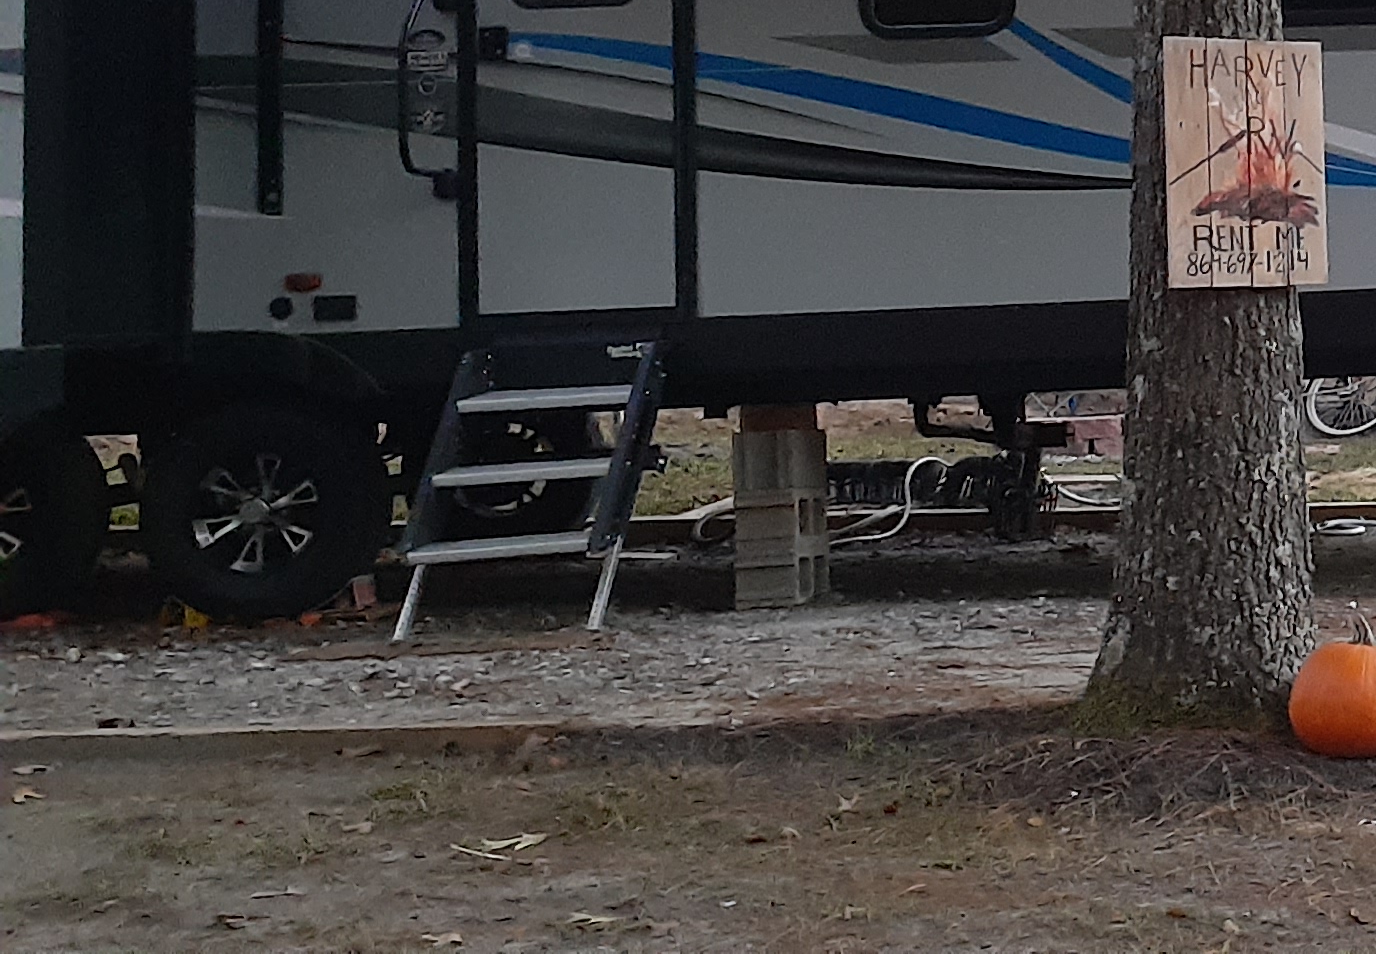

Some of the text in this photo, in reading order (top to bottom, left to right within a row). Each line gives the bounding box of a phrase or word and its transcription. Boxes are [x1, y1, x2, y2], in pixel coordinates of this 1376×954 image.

[1189, 49, 1307, 97] HARVEY
[1193, 224, 1305, 252] RENT ME
